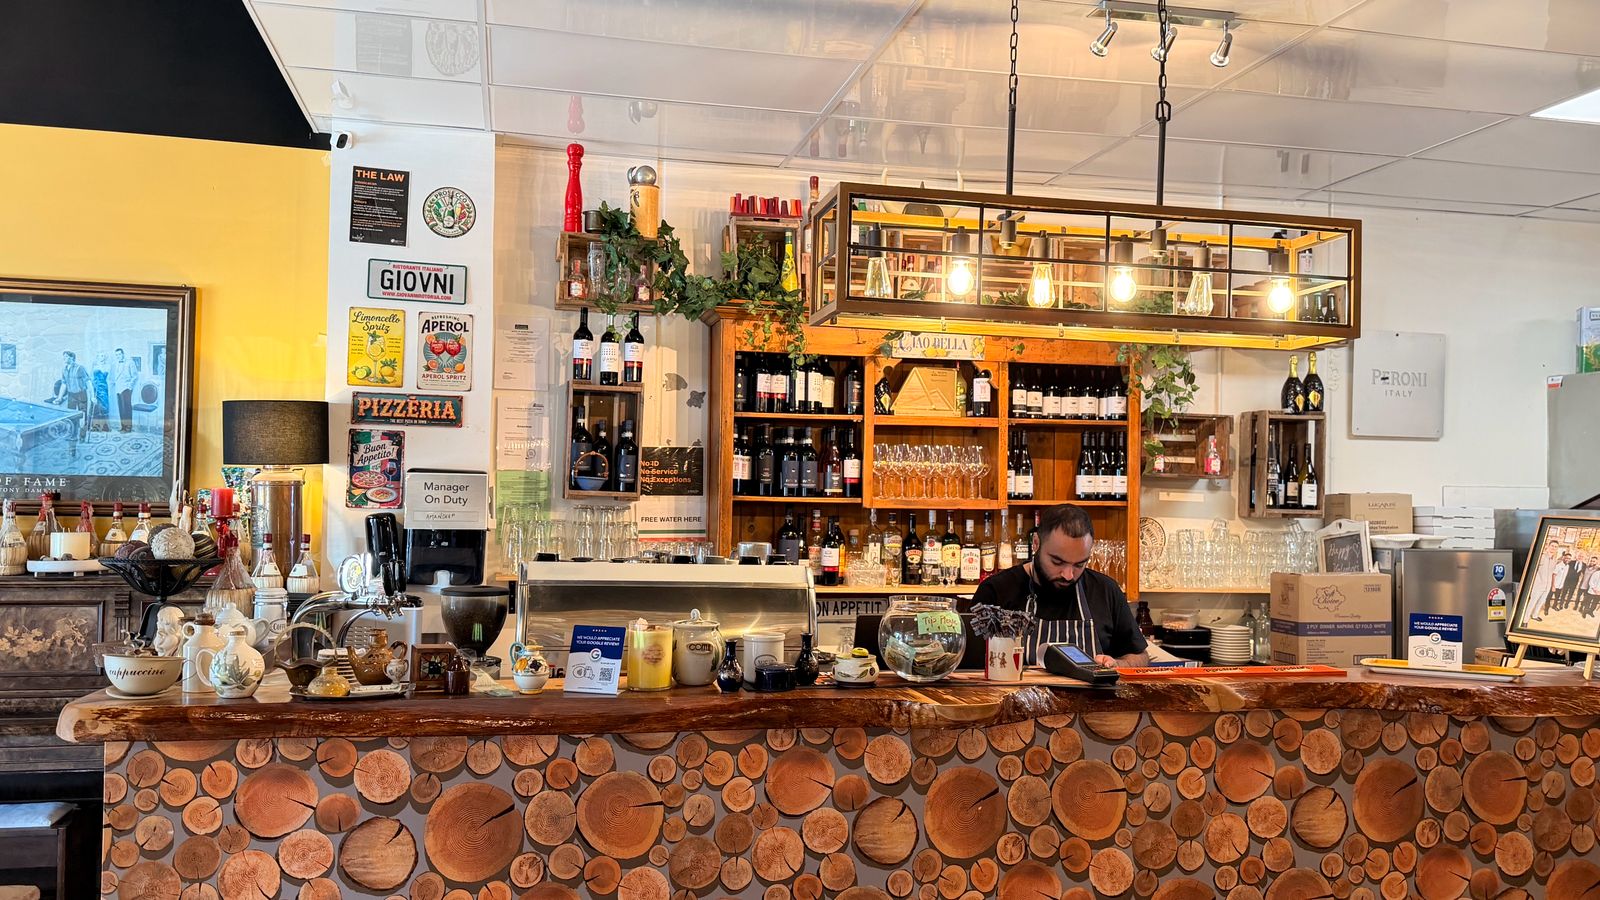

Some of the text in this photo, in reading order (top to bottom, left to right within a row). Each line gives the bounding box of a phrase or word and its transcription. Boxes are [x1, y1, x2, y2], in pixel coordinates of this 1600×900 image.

[355, 169, 405, 183] THE LAW
[434, 190, 467, 203] PROSCCO
[380, 269, 454, 294] GIOVNI
[352, 311, 401, 324] Limoncello
[362, 322, 391, 334] Spritz
[421, 320, 470, 334] APEROL
[933, 337, 968, 350] BELLA
[1371, 368, 1428, 387] PERONI
[1384, 390, 1413, 398] ITALY
[363, 443, 386, 454] Buon
[356, 448, 394, 465] Appetito!
[0, 476, 67, 487] F FAME
[651, 476, 692, 484] Exceptions
[424, 482, 470, 494] Manager
[424, 494, 468, 506] On Duty
[1328, 543, 1353, 561] Happy
[1324, 588, 1336, 598] Soft
[1318, 596, 1340, 604] Choice
[832, 601, 882, 616] APPETIT
[922, 616, 936, 627] Tip
[109, 667, 166, 680] cappuccino
